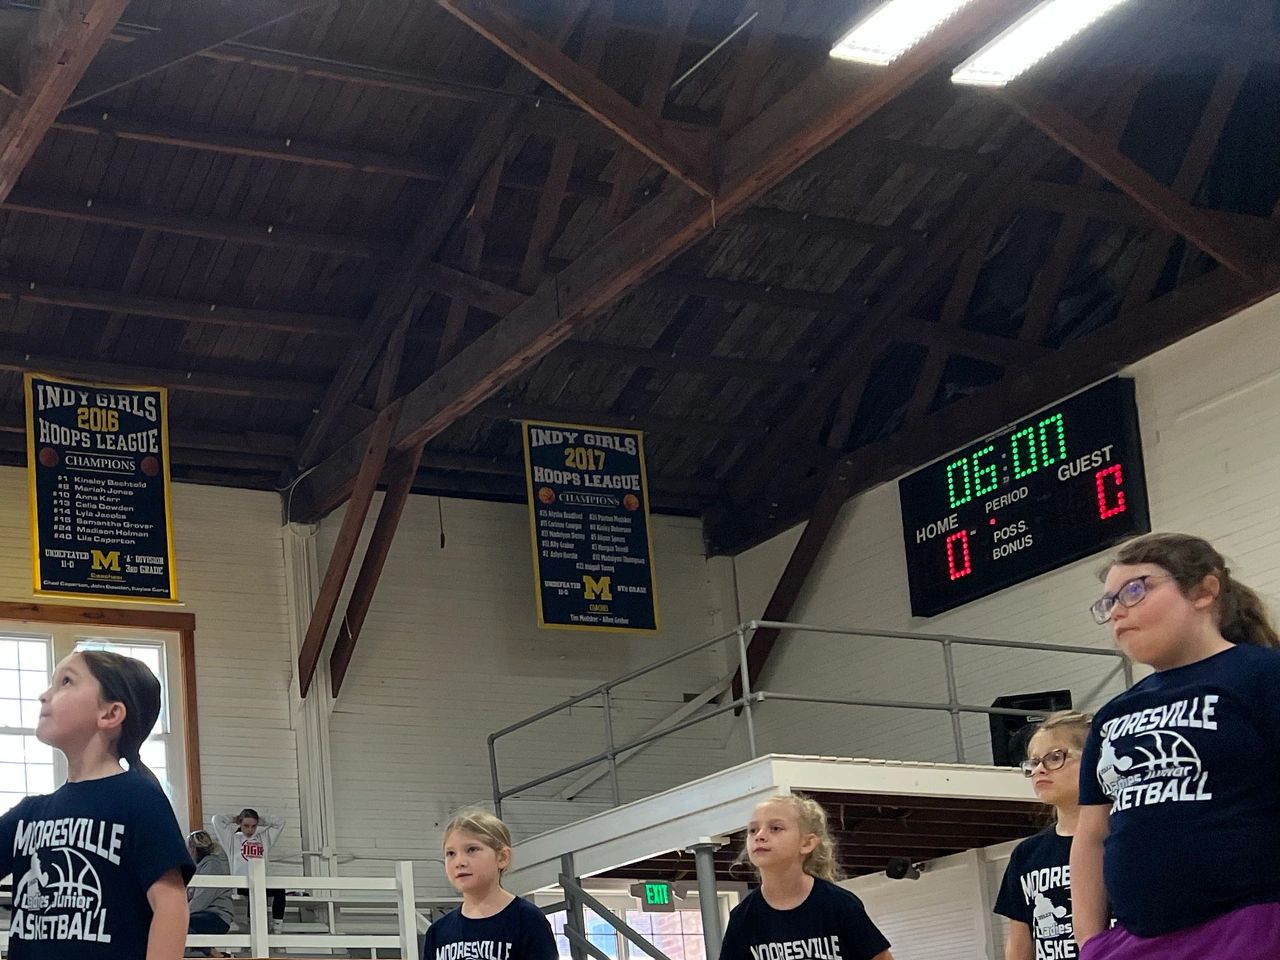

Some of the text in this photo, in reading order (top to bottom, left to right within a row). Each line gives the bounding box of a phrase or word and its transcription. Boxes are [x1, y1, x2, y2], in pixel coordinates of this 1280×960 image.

[37, 384, 157, 422] INDY GIRLS
[77, 406, 120, 432] 2016
[39, 416, 159, 454] HOOPS LEAGUE
[531, 428, 636, 456] INDY GIRLS
[65, 455, 136, 471] CHAMPIONS
[564, 447, 606, 471] 2017
[946, 413, 1066, 509] 06:00
[1057, 444, 1114, 481] GUEST
[74, 476, 106, 487] Kinsley
[533, 465, 640, 491] HOOPS LEAGUE
[75, 493, 98, 501] Anna
[107, 487, 133, 496] Jones
[559, 493, 620, 506] CHAMPIONS
[985, 486, 1029, 513] PERIOD
[76, 518, 122, 527] Samantha
[123, 521, 154, 529] Grover
[76, 526, 114, 535] Madison
[115, 529, 149, 538] Holman
[916, 514, 959, 544] HOME
[45, 549, 89, 560] UNDEFEATED
[946, 529, 972, 581] 0
[992, 534, 1034, 560] BONUS
[90, 549, 121, 572] M
[135, 555, 164, 565] DIVISION
[139, 565, 163, 575] GRADE
[582, 575, 613, 601] M
[13, 817, 125, 866] MOORESVILLE
[51, 891, 95, 909] Junior
[645, 884, 669, 904] EXIT
[10, 908, 112, 943] ASKETBALL
